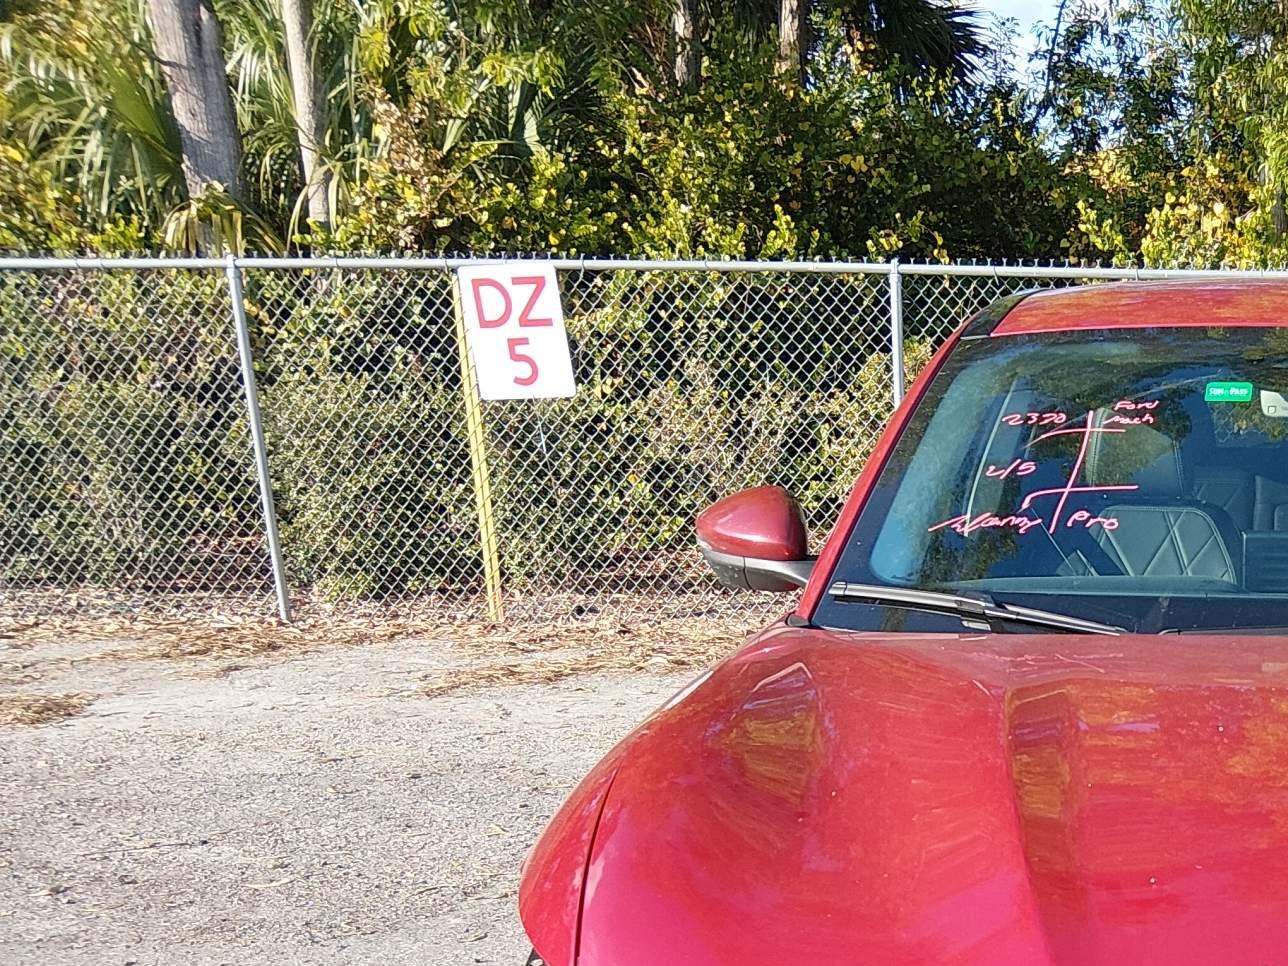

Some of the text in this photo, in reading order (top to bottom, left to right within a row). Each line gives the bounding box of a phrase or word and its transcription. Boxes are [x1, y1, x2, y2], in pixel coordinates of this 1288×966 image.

[471, 276, 553, 328] DZ
[507, 337, 539, 386] 5
[1114, 400, 1159, 411] Ford
